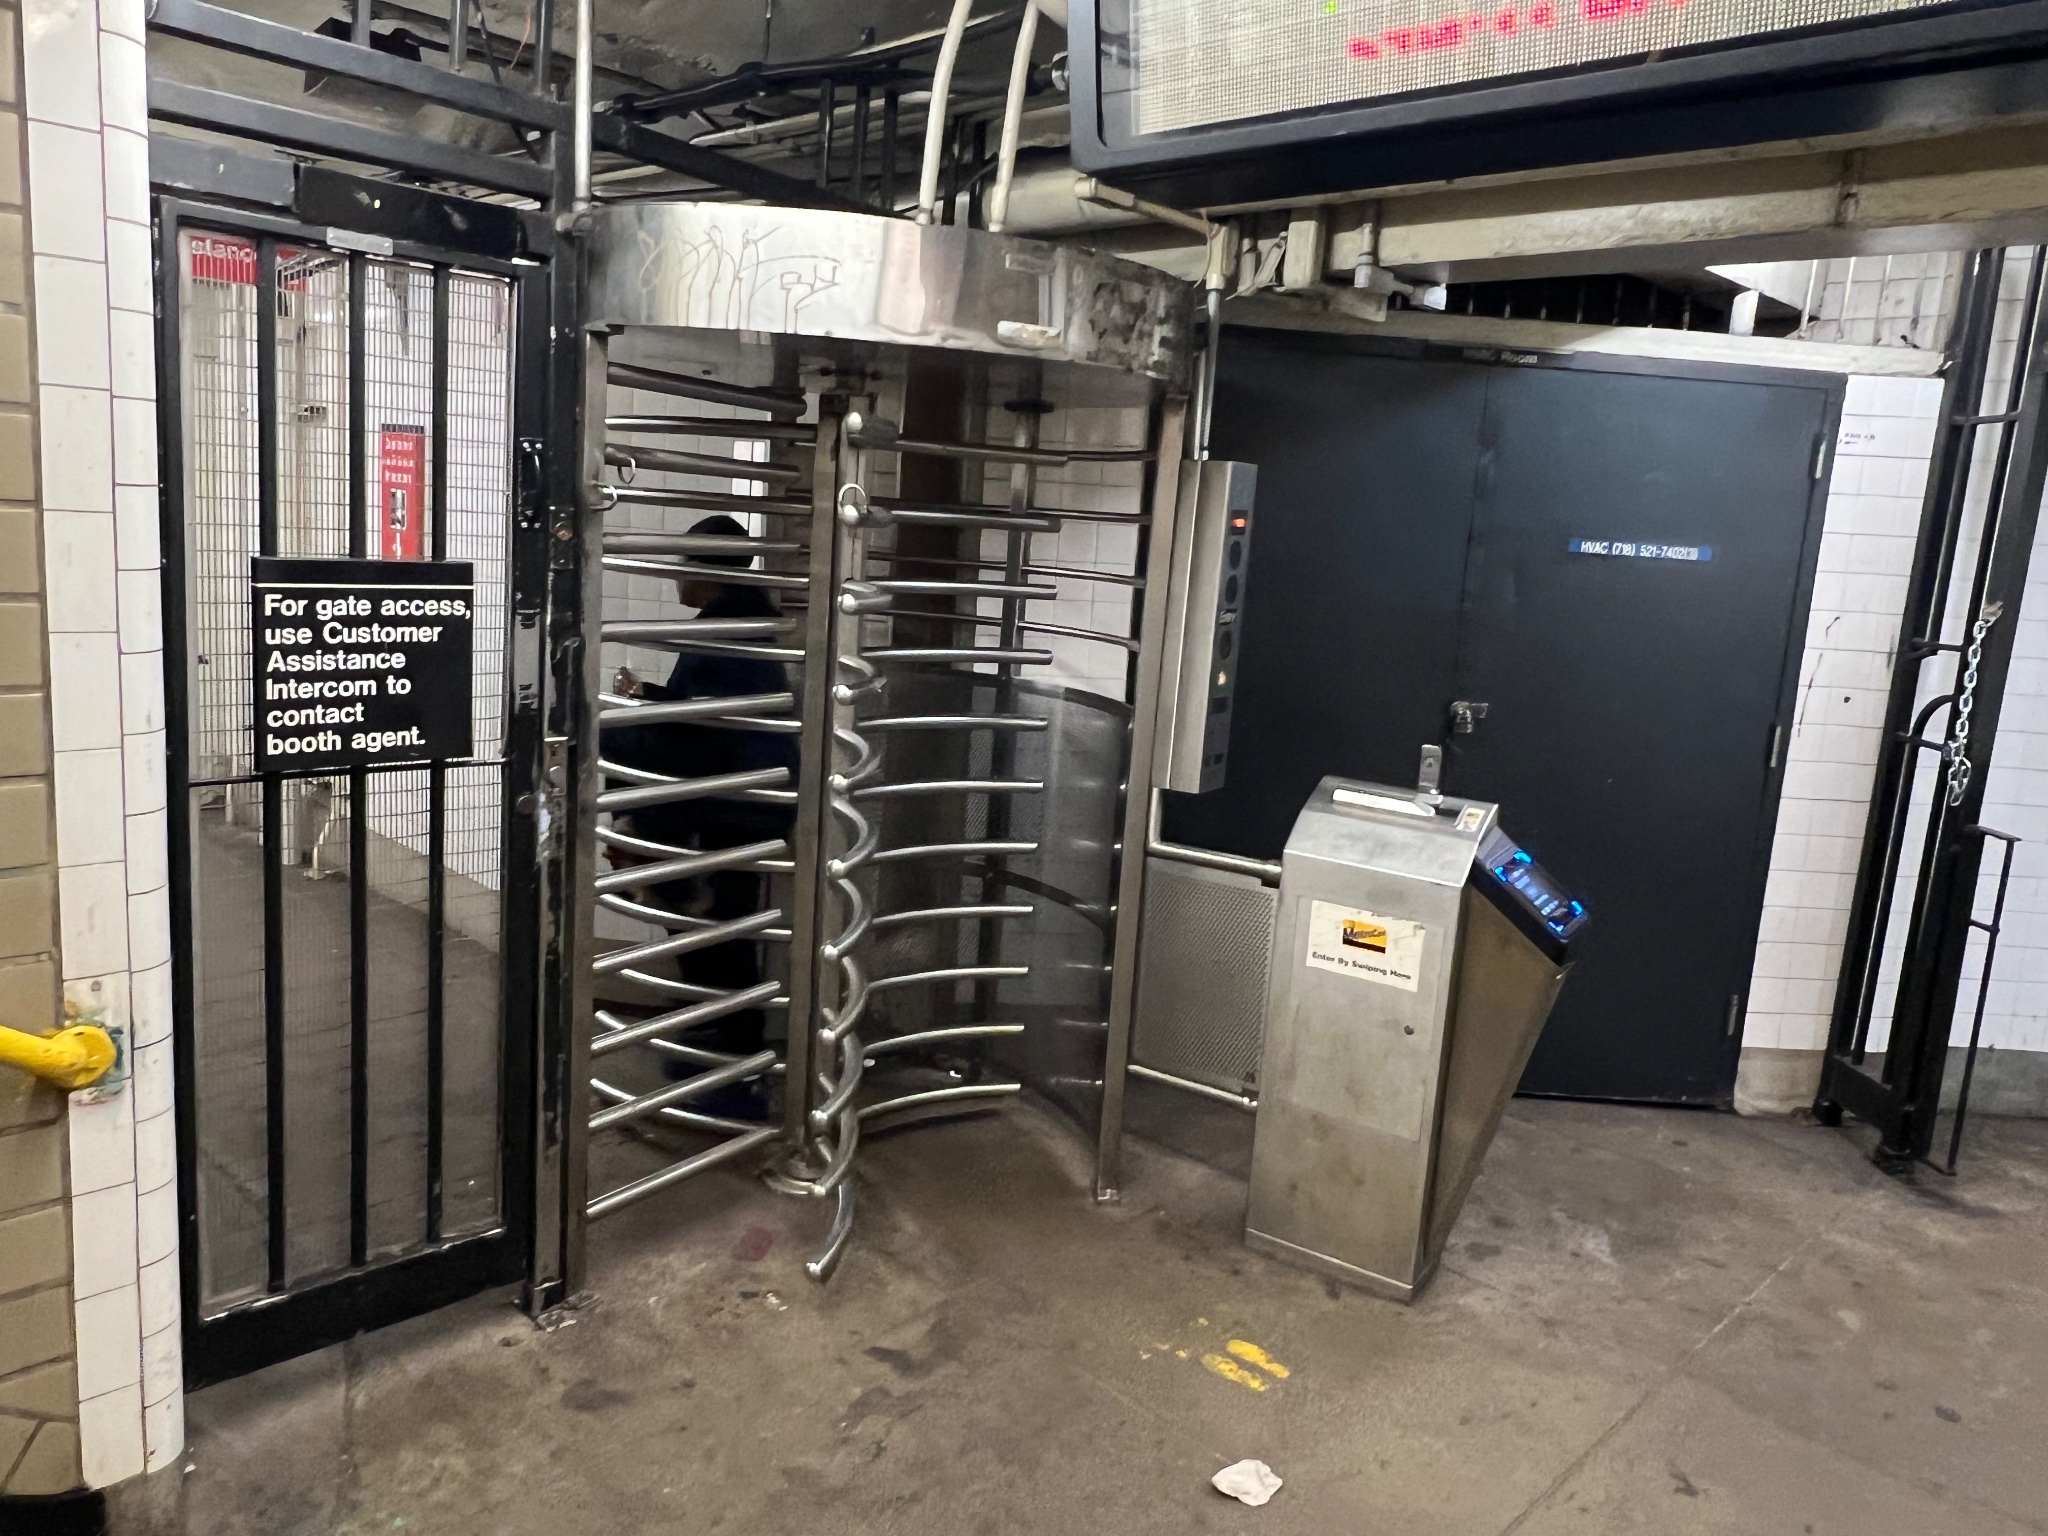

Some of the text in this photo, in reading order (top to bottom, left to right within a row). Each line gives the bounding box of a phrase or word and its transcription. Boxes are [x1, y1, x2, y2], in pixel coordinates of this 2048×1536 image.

[1580, 541, 1609, 554] HVAC
[1612, 543, 1636, 556] (718)
[264, 594, 471, 620] For gate access,
[265, 622, 443, 645] use Customer
[267, 650, 406, 672] Assistance
[266, 675, 411, 700] Intercom to
[267, 702, 365, 727] contact
[267, 726, 426, 755] booth agent.
[1312, 951, 1335, 962] Enter
[1338, 957, 1349, 967] By
[1352, 960, 1388, 976] Swiping
